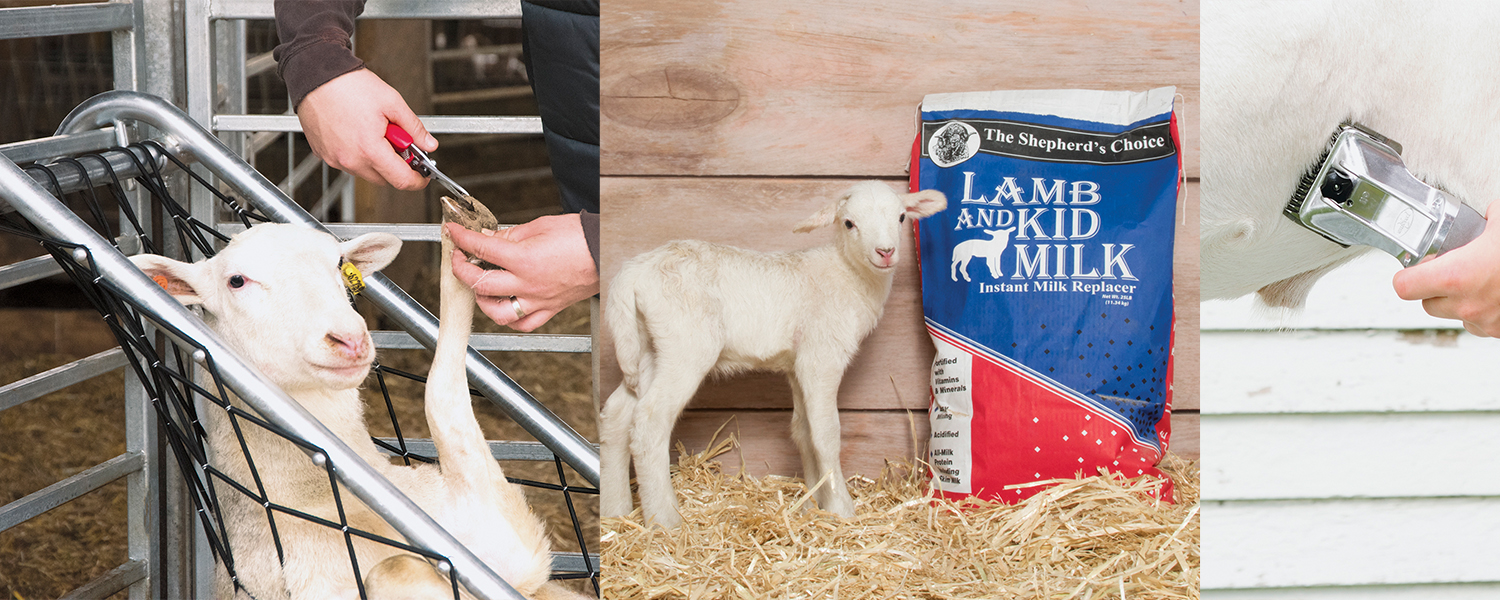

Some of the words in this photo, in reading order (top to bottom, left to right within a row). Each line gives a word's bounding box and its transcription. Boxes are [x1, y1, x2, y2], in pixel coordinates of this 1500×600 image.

[984, 127, 1014, 143] The
[1018, 132, 1106, 154] Shepherd's
[1110, 134, 1165, 154] Choice
[961, 171, 1102, 206] LAMB
[954, 208, 1014, 230] AND
[1015, 208, 1101, 241] KID
[1011, 243, 1139, 281] MILK
[979, 282, 1029, 294] Instant
[1033, 281, 1067, 293] Milk
[1072, 281, 1137, 295] Replacer
[934, 357, 957, 366] ortified
[940, 385, 967, 394] Minerals
[933, 430, 959, 438] Acidified
[934, 458, 953, 466] Protein
